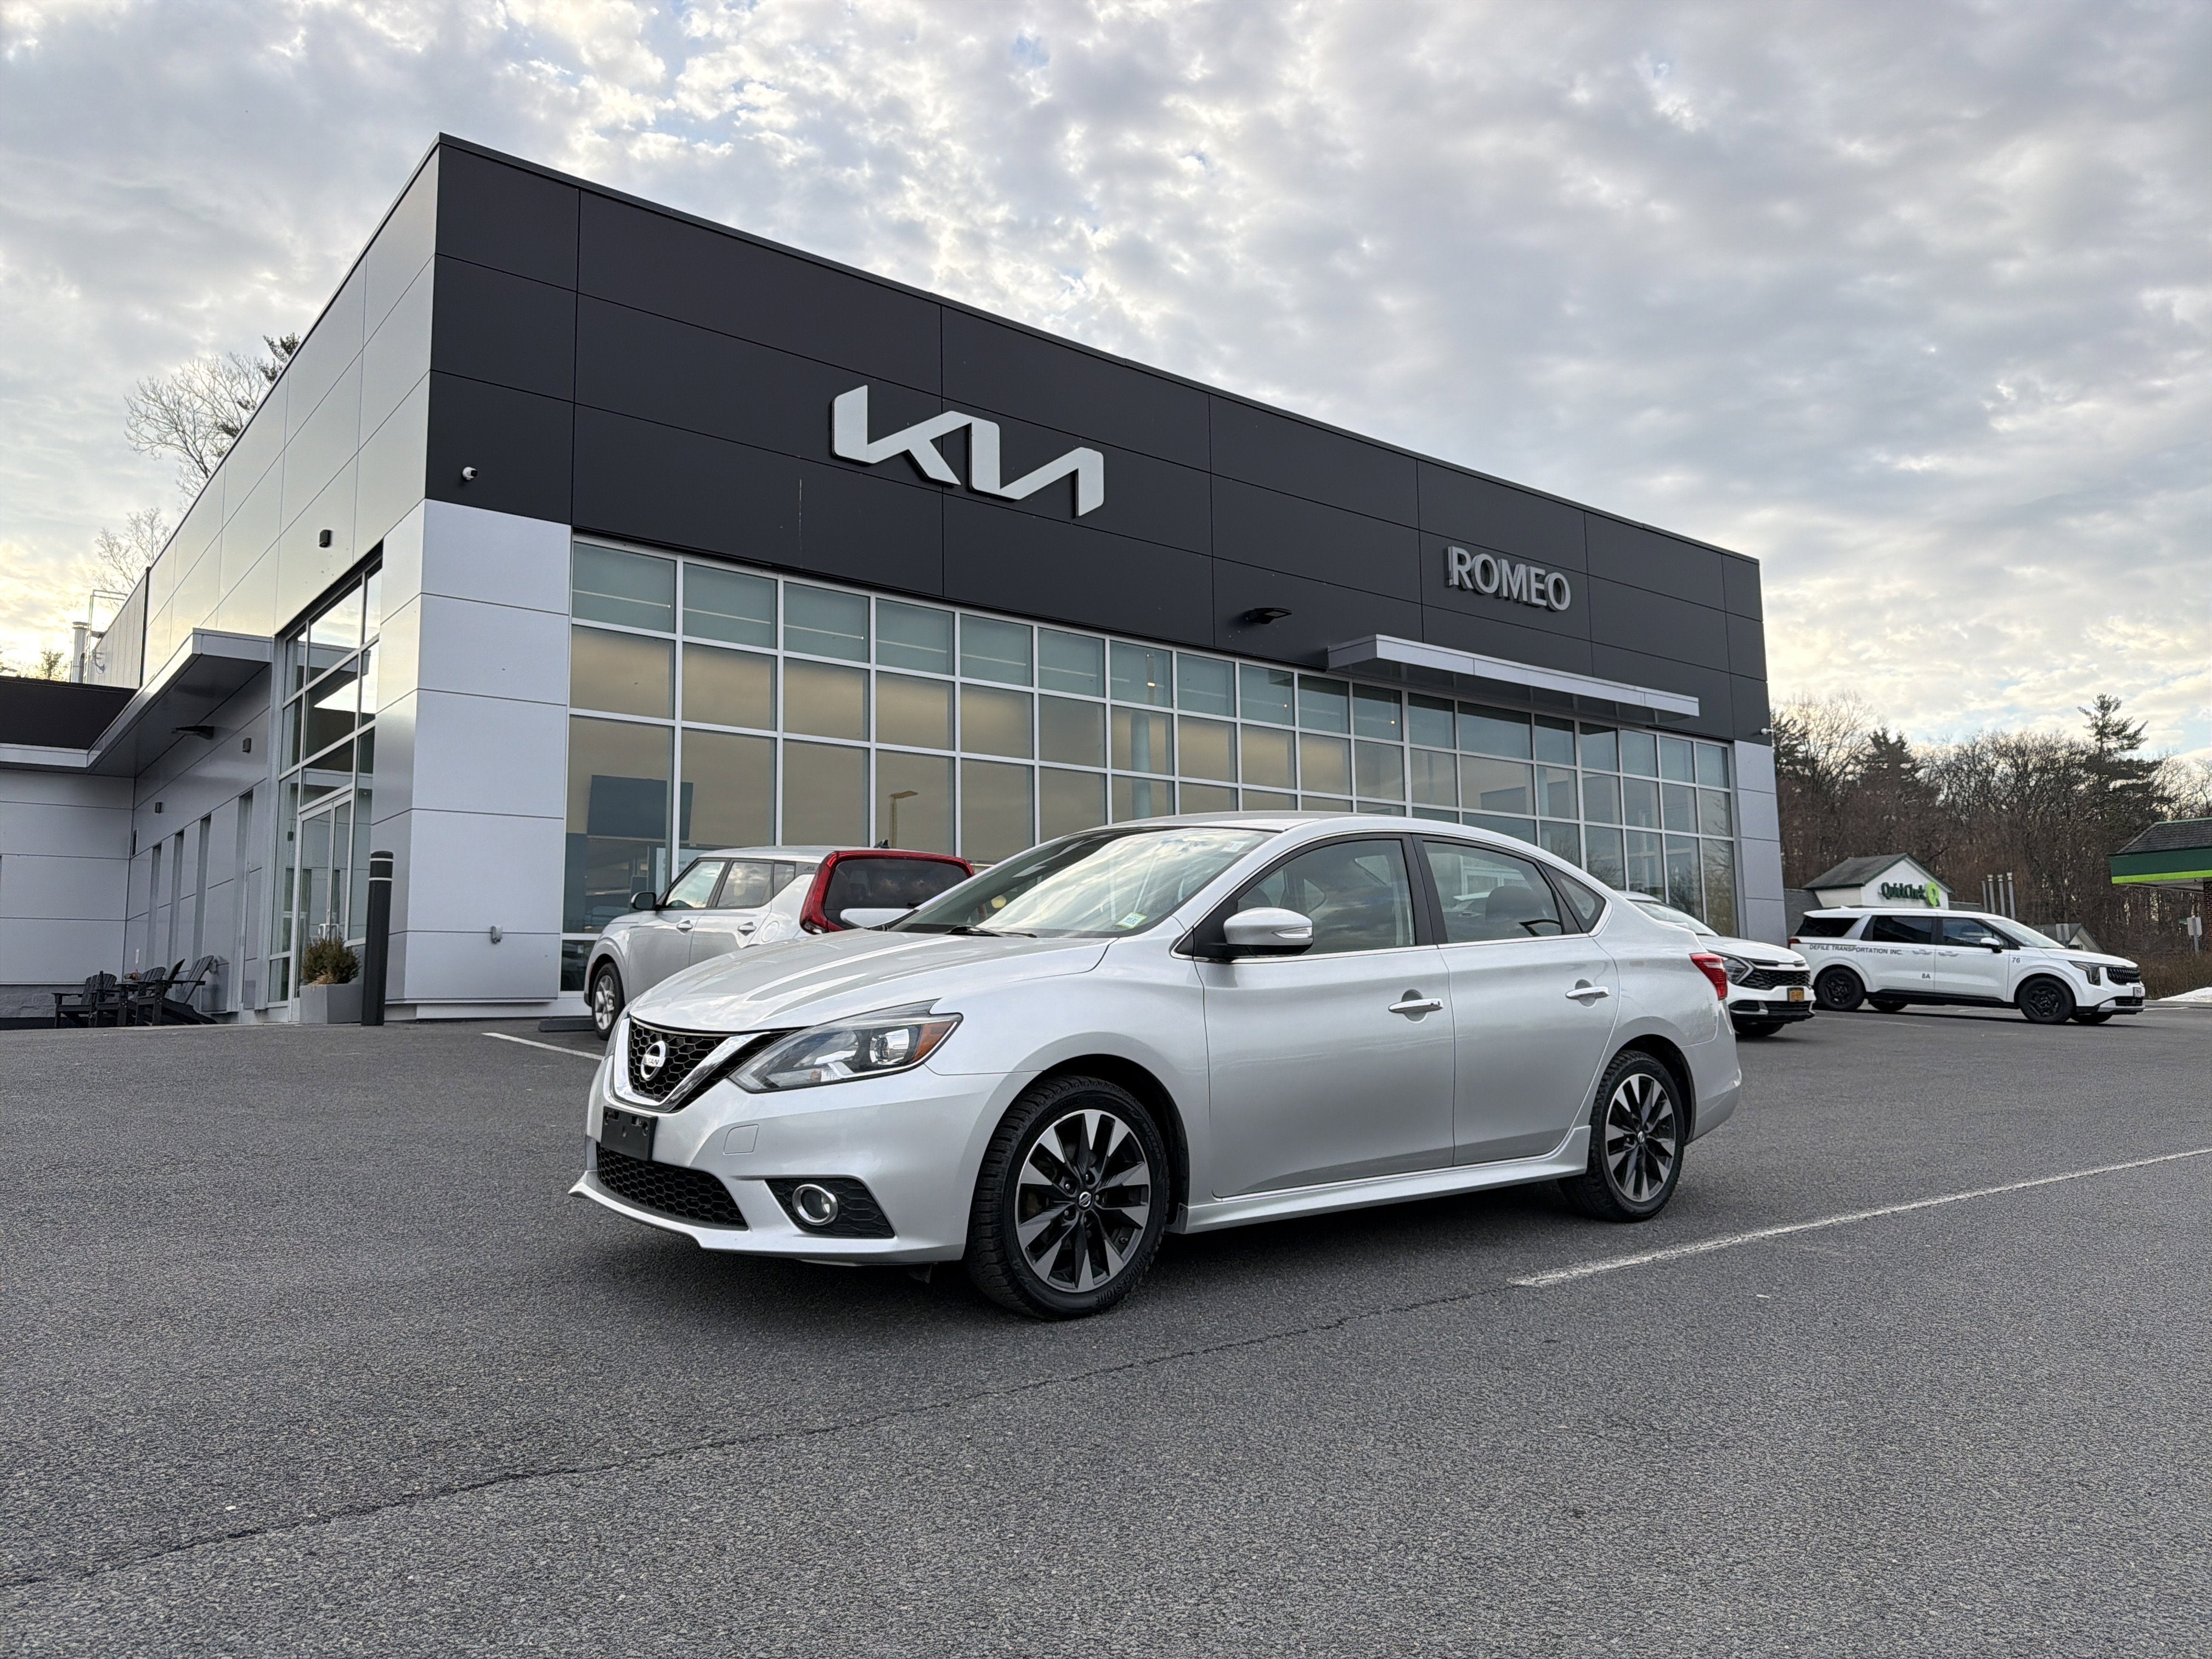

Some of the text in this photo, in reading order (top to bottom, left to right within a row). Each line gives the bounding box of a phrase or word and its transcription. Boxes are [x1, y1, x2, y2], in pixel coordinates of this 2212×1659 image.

[832, 384, 1104, 517] KIA
[1445, 546, 1571, 611] ROMEO
[1832, 945, 1888, 955] TRANSPORTATION
